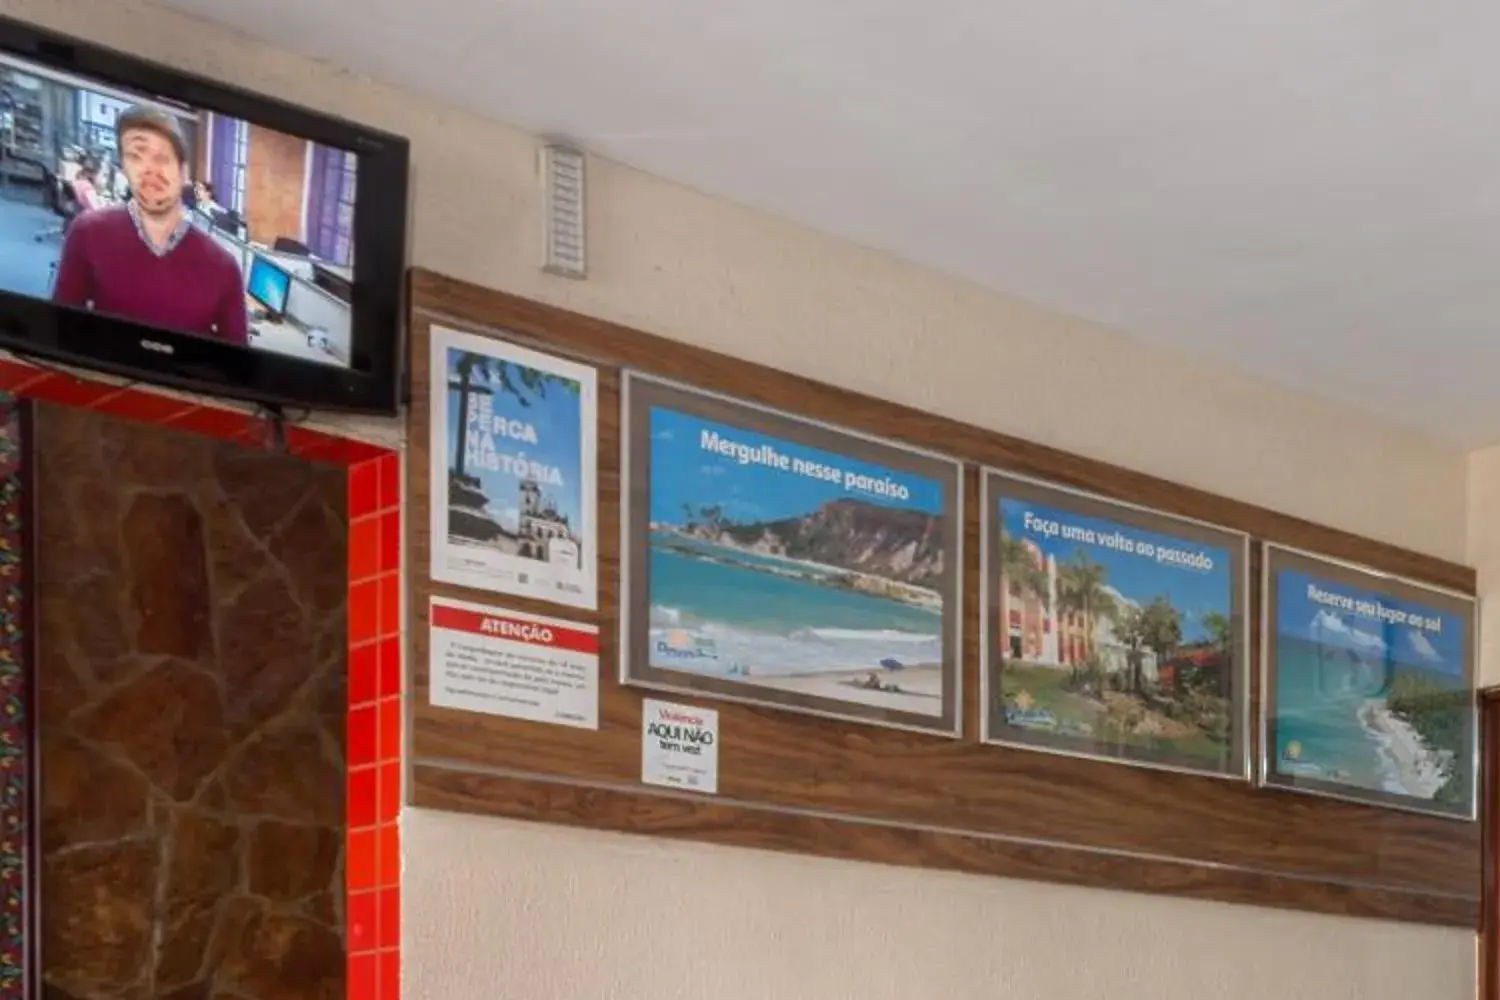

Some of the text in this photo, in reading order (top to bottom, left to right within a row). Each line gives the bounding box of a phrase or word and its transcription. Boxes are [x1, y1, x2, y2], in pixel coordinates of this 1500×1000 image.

[701, 430, 909, 500] Mergulhe nesse paraíso
[1024, 511, 1213, 570] Faça uma volta ao passado
[480, 617, 553, 642] ATENÇÃO
[648, 722, 713, 746] AQUI NÃO
